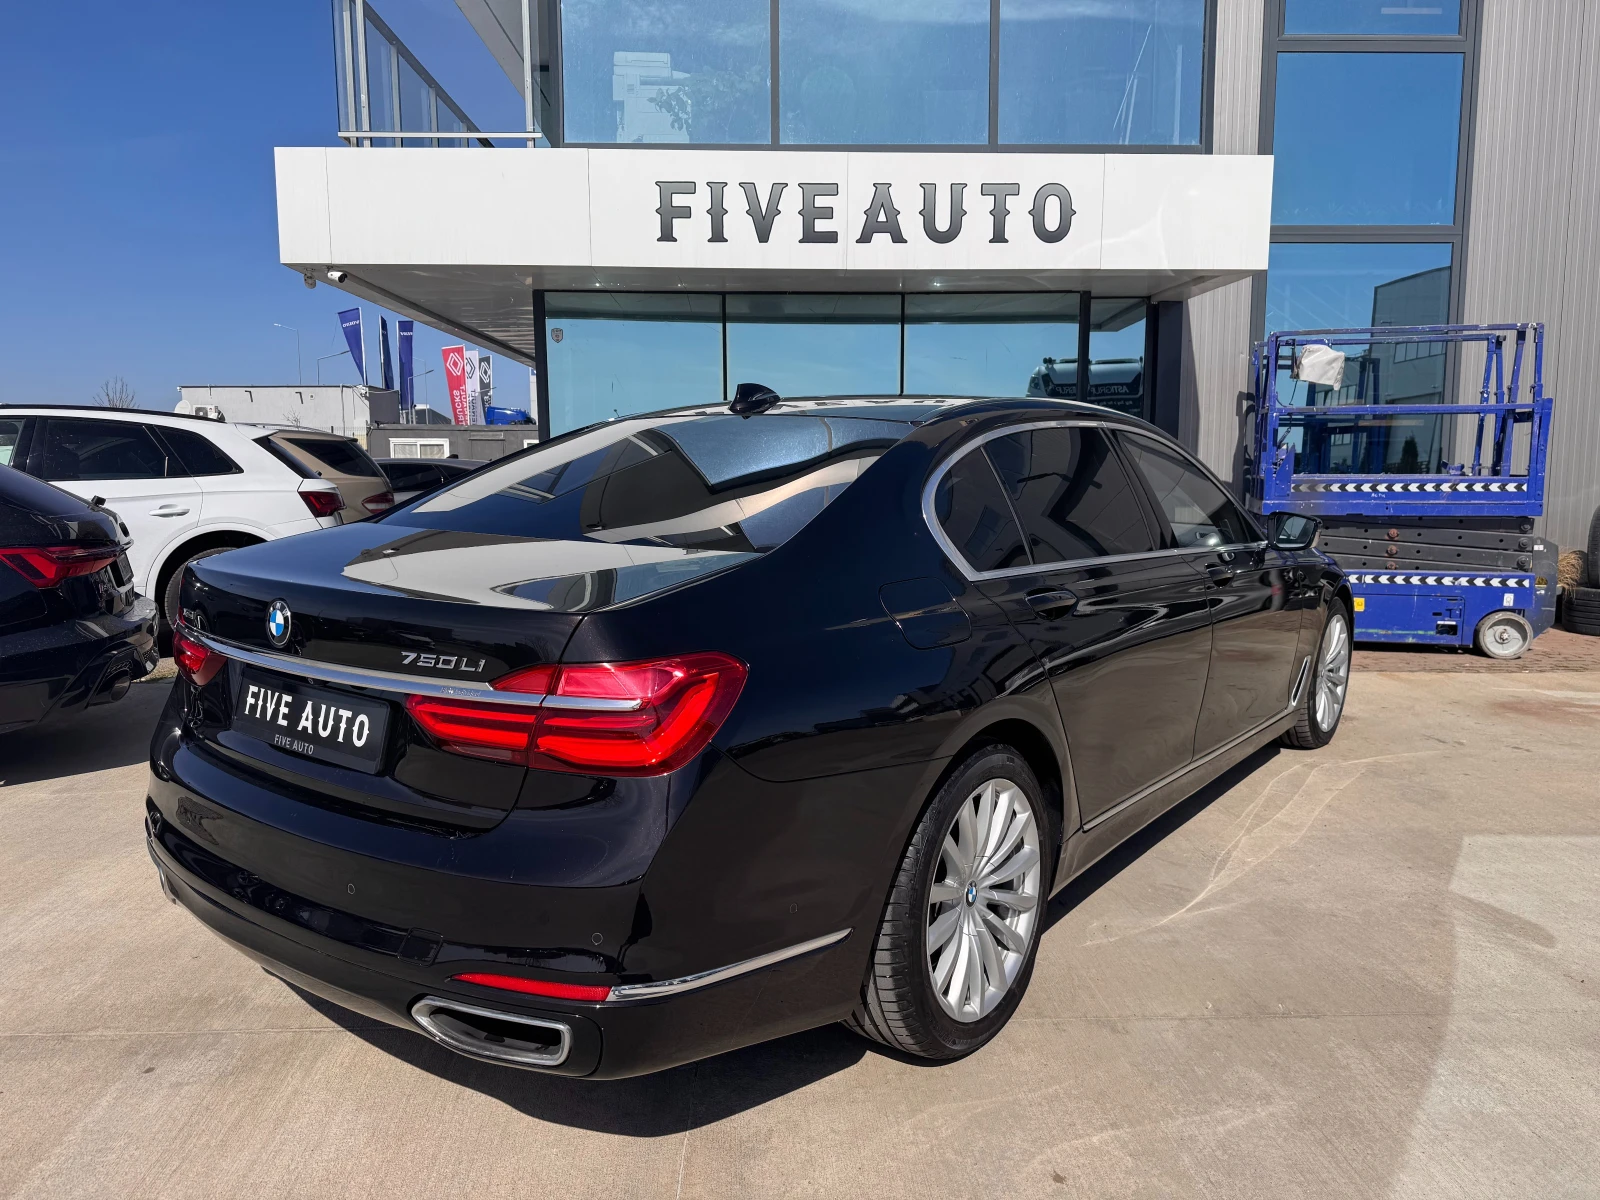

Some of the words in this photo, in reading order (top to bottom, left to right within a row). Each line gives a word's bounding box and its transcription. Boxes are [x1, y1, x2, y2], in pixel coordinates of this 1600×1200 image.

[243, 684, 293, 727] FIVE
[296, 700, 370, 748] AUTO
[273, 734, 292, 749] FIVE
[292, 742, 314, 755] AUTO
